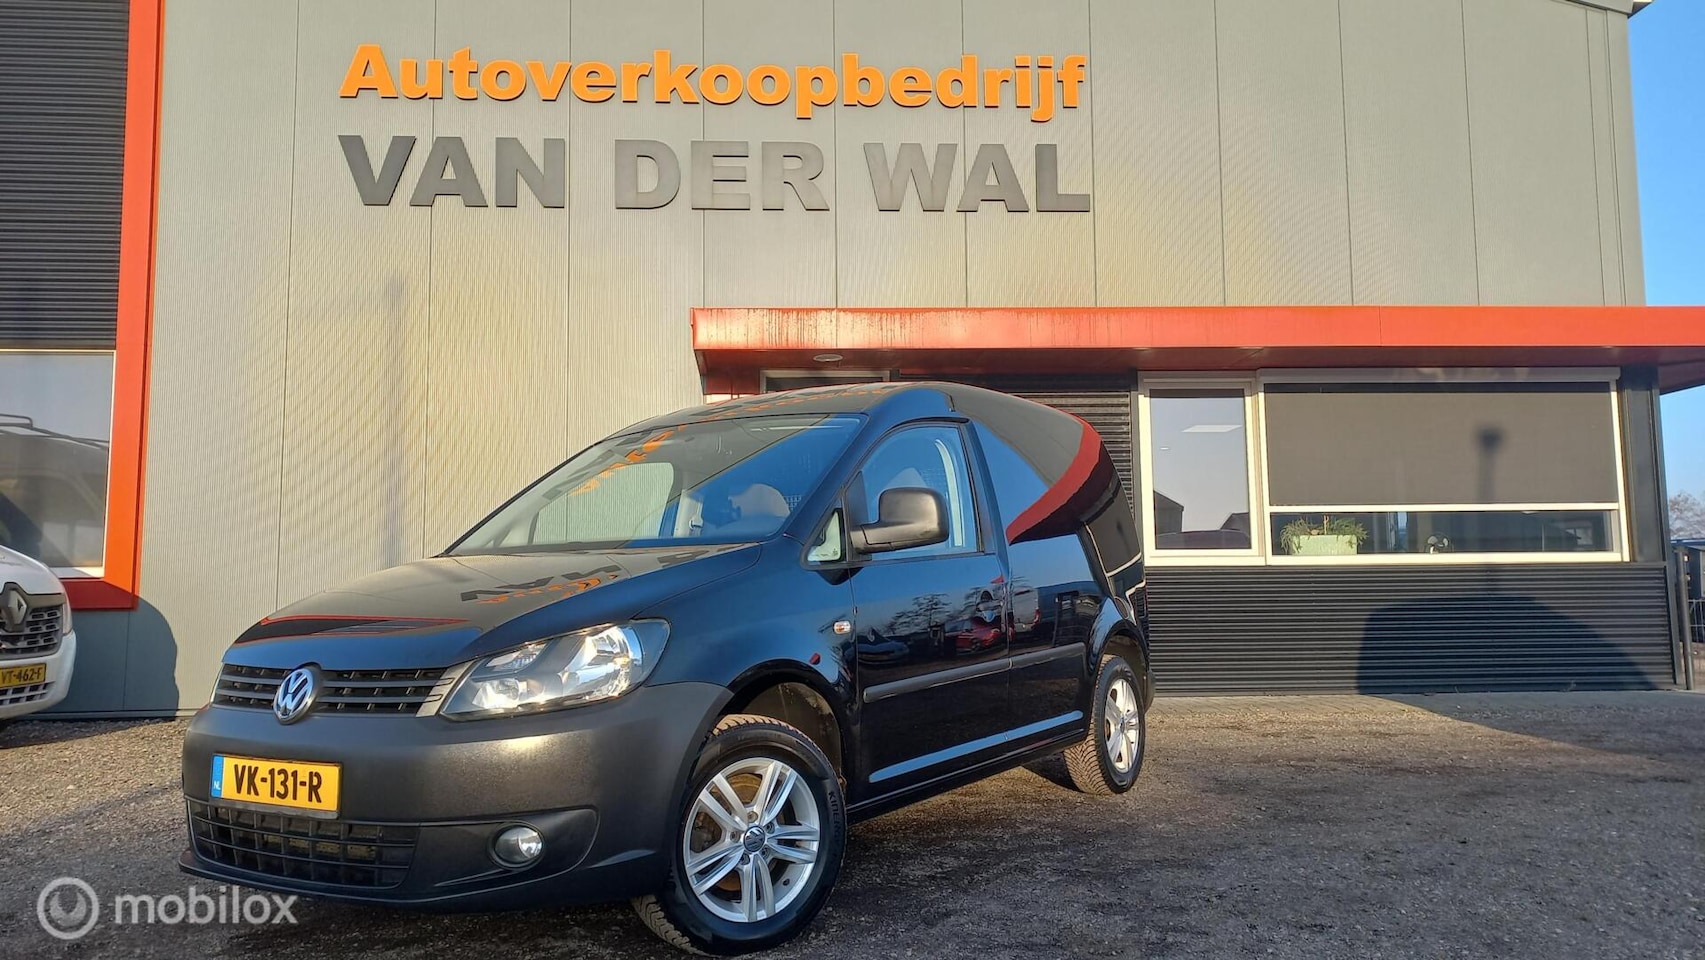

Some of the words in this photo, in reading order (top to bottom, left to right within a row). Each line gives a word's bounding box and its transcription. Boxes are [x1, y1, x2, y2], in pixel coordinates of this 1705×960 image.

[338, 44, 1087, 122] Autoverkoopbedrijf
[338, 135, 566, 208] VAN
[615, 139, 830, 211] DER
[863, 142, 1091, 212] WAL
[213, 781, 221, 791] NL
[234, 764, 322, 803] VK-131-R
